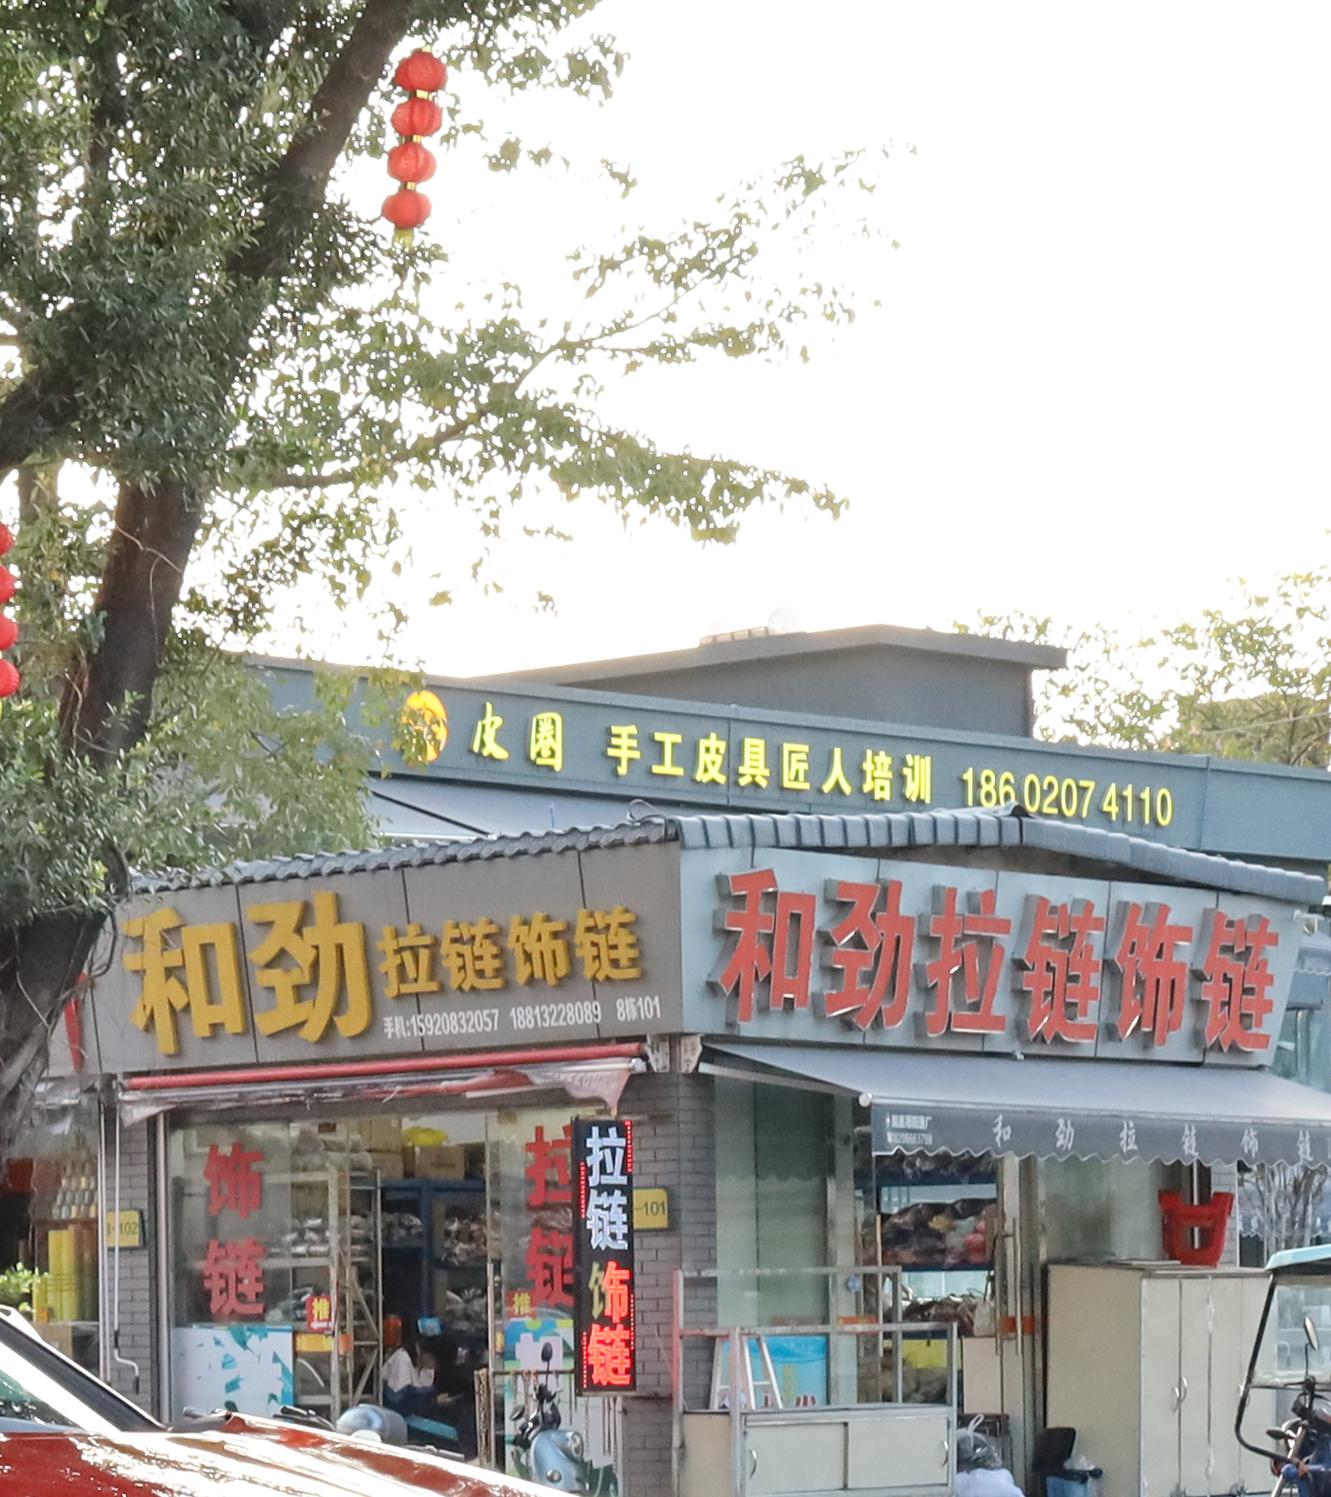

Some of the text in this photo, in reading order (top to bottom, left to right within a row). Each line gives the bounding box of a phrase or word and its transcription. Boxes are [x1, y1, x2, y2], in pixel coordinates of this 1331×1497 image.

[470, 701, 565, 772] 皮圈
[606, 723, 933, 805] 手工皮具匠人培训
[122, 890, 642, 1057] 和劲 拉链饰链
[509, 1000, 603, 1031] 18813228089
[713, 867, 1281, 1052] 和劲拉链饰链
[202, 1142, 266, 1315] 饰链
[311, 1297, 331, 1321] 推
